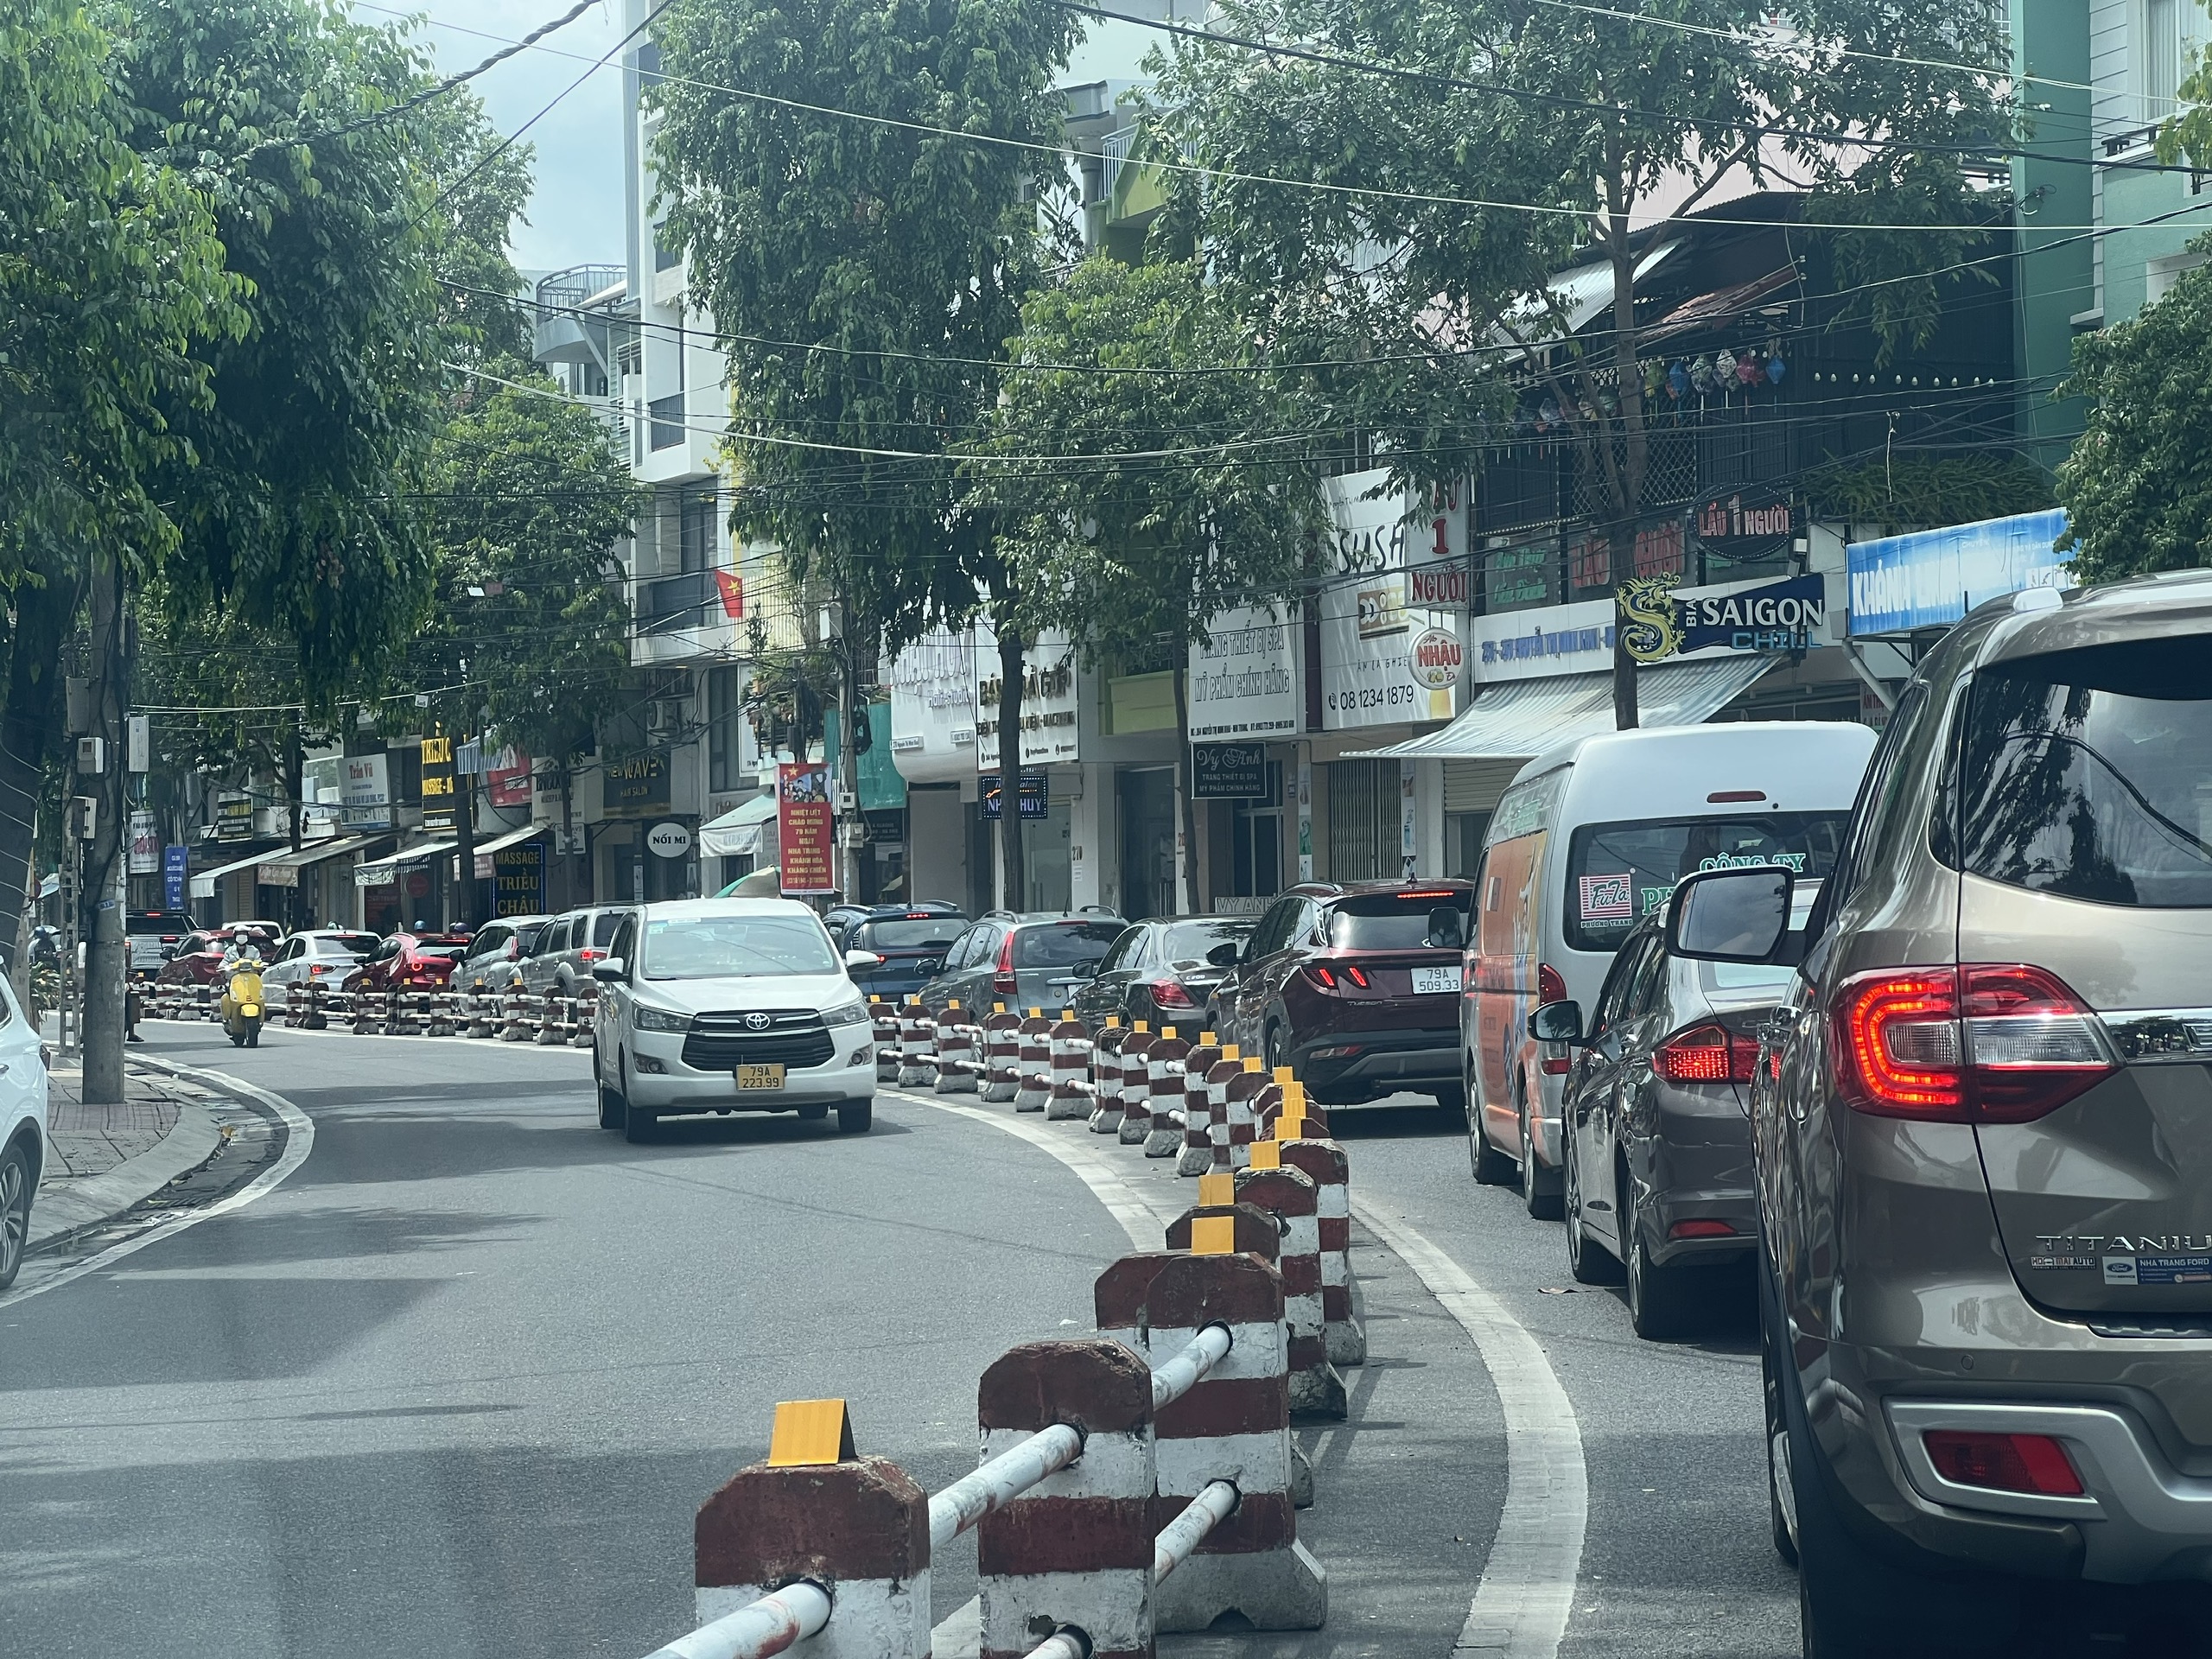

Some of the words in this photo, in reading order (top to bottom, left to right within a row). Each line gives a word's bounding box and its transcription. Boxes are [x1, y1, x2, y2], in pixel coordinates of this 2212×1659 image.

[1728, 495, 1741, 536] 1
[1745, 504, 1789, 535] NGƯỜI
[1432, 518, 1449, 555] 1
[1852, 559, 1911, 617] KHÁNH
[1686, 598, 1697, 627] BIA
[1702, 598, 1823, 626] SAIGON
[1268, 626, 1285, 652] SPA
[1732, 631, 1823, 649] CHILL
[1417, 639, 1461, 671] NHẬU
[1236, 666, 1262, 698] CHÍNH
[1340, 691, 1357, 710] 08
[1359, 689, 1384, 709] 1234
[1387, 684, 1414, 706] 1879
[1197, 748, 1220, 771] Vy
[1222, 747, 1262, 768] Anh
[1020, 798, 1042, 812] HUY
[652, 833, 671, 844] NỐI
[495, 852, 540, 865] MASSAGE
[1772, 853, 1807, 873] TY
[497, 868, 539, 891] TRIỀU
[497, 896, 539, 914] CHÂU
[1217, 898, 1243, 913] VY
[1610, 918, 1633, 927] TRANG
[1427, 969, 1449, 979] 79A
[1419, 979, 1459, 991] 509.33
[750, 1066, 771, 1077] 79A
[742, 1077, 779, 1088] 223.99
[2073, 1256, 2095, 1266] AUTO
[2187, 1257, 2209, 1266] FORD
